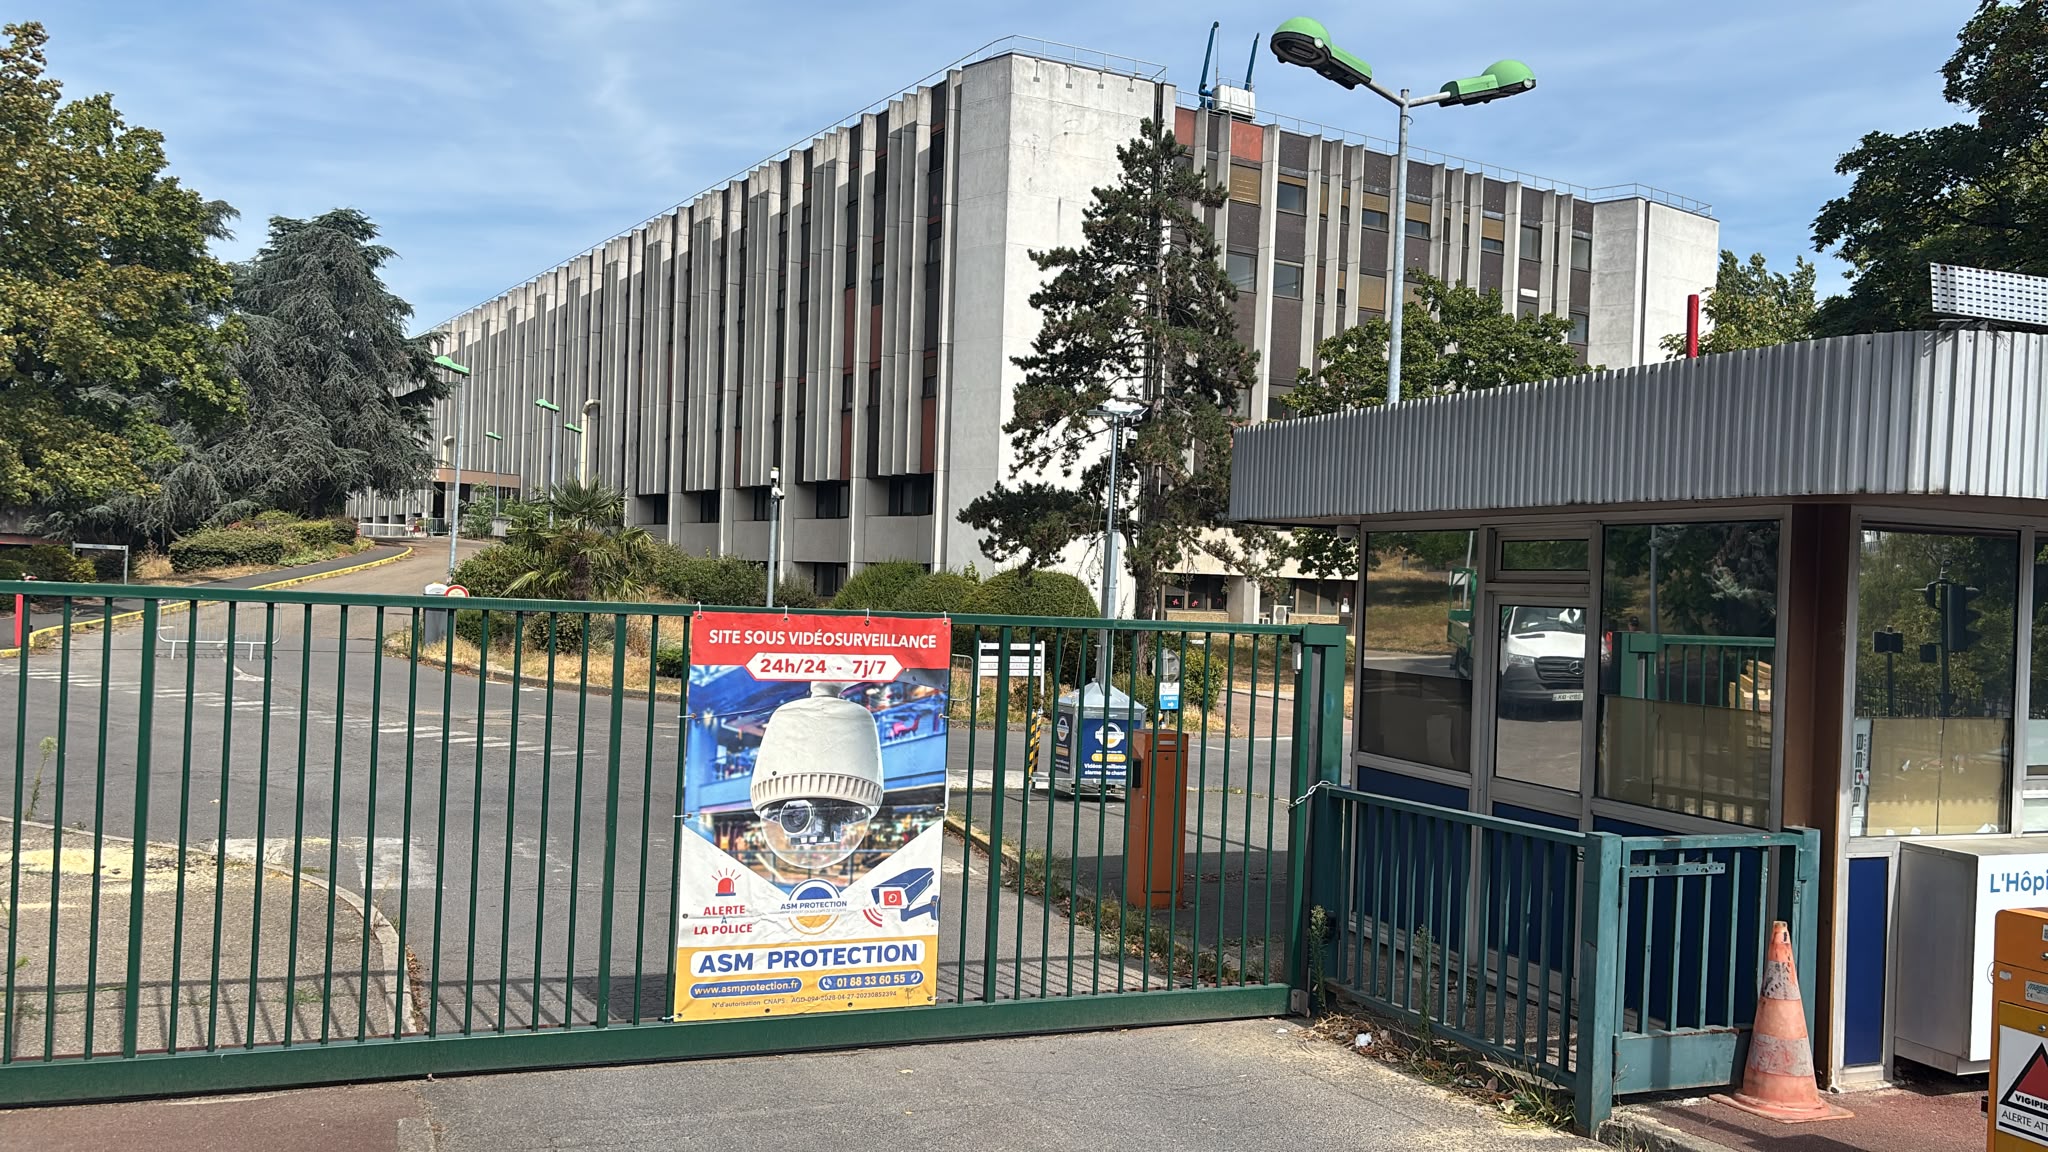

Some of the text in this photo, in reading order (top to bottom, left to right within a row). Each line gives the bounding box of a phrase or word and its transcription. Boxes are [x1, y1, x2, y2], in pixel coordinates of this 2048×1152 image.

[709, 628, 937, 649] SITE SOUS VIDÉOSURVEILLANCE
[760, 658, 827, 674] 24h/24
[852, 660, 886, 678] 7j/7
[703, 905, 746, 916] ALERTE
[799, 900, 848, 909] PROTECTION
[694, 923, 753, 935] LA POLICE
[698, 943, 918, 974] ASM PROTECTION
[694, 980, 799, 995] www.asmprotection.fr
[836, 974, 906, 988] 01 88 33 60 55
[2001, 1110, 2032, 1127] ALERTE
